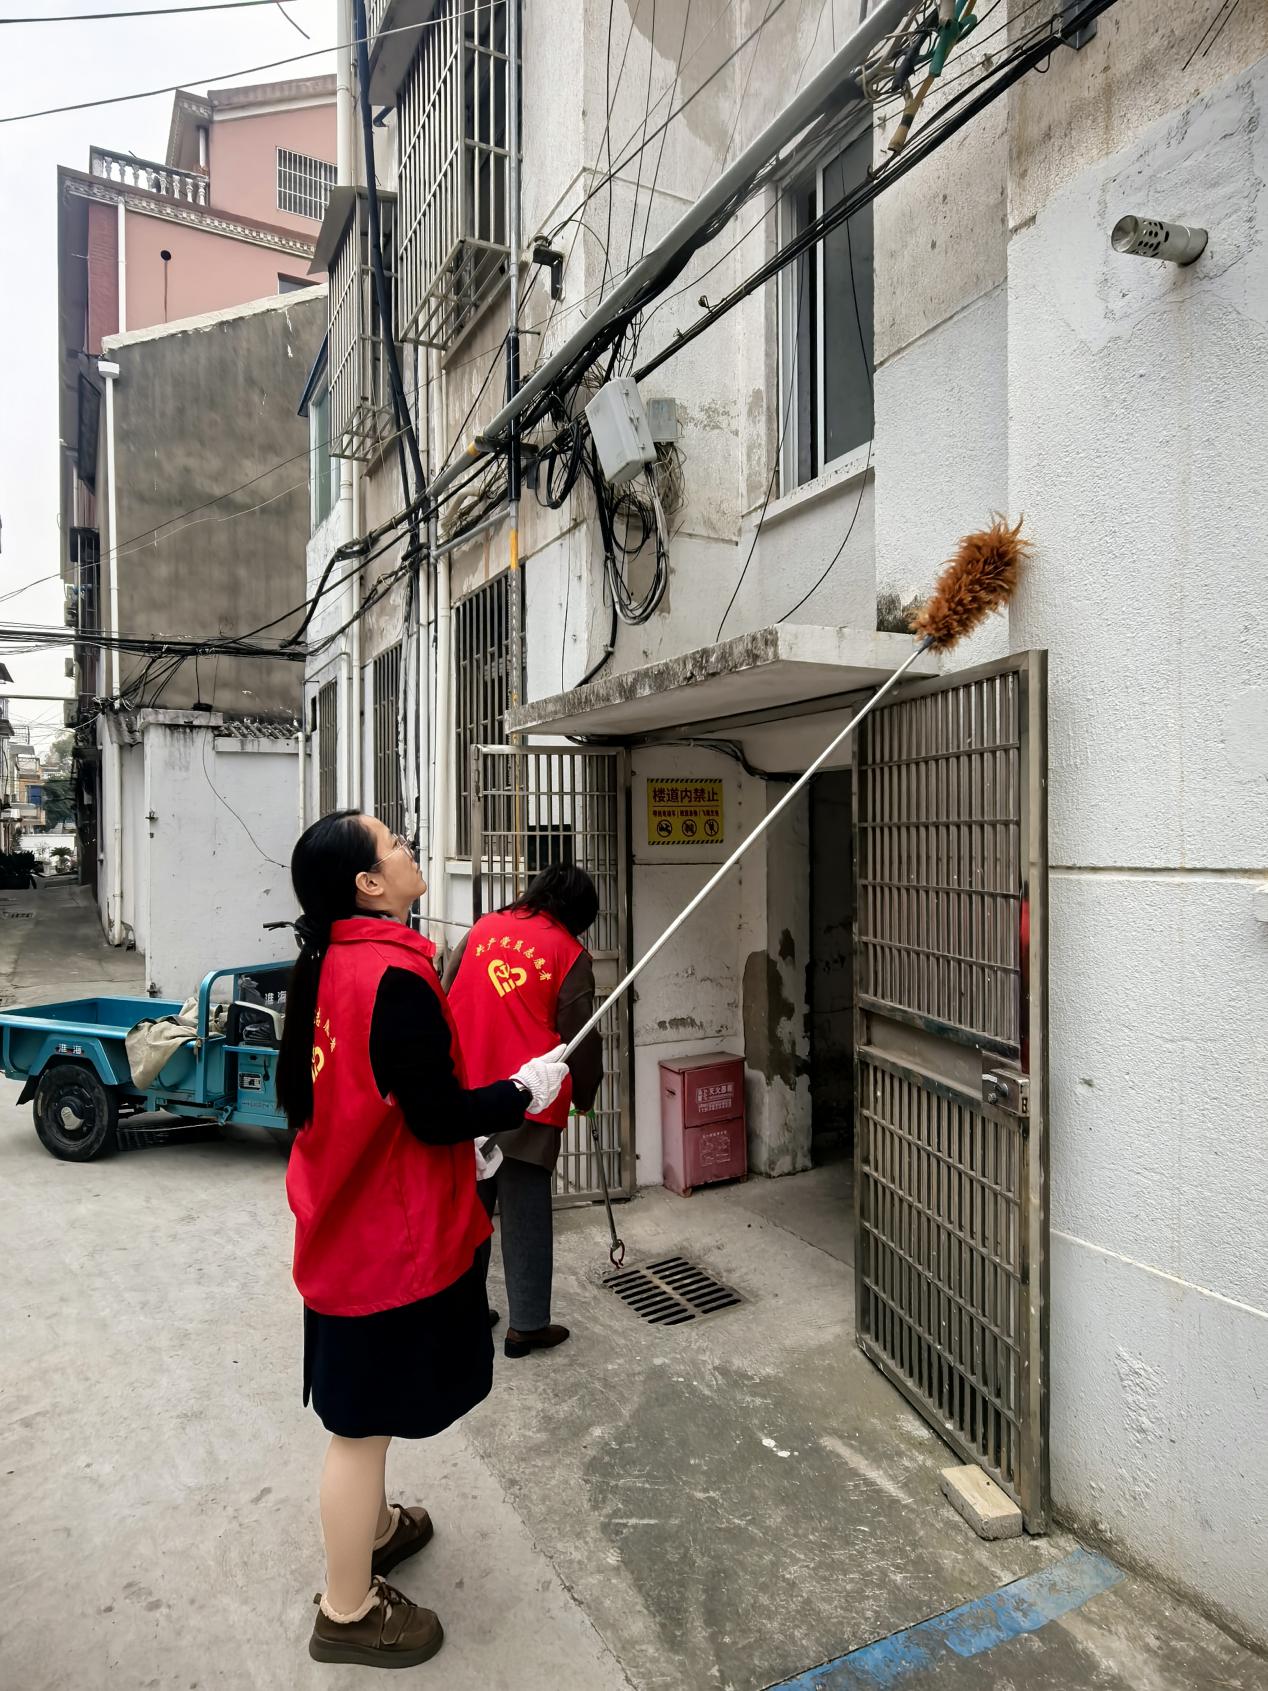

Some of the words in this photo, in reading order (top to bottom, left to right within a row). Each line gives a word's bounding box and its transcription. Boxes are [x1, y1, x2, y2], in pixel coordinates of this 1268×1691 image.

[653, 787, 719, 803] 楼道内禁止
[476, 936, 552, 981] 共产党员志愿者
